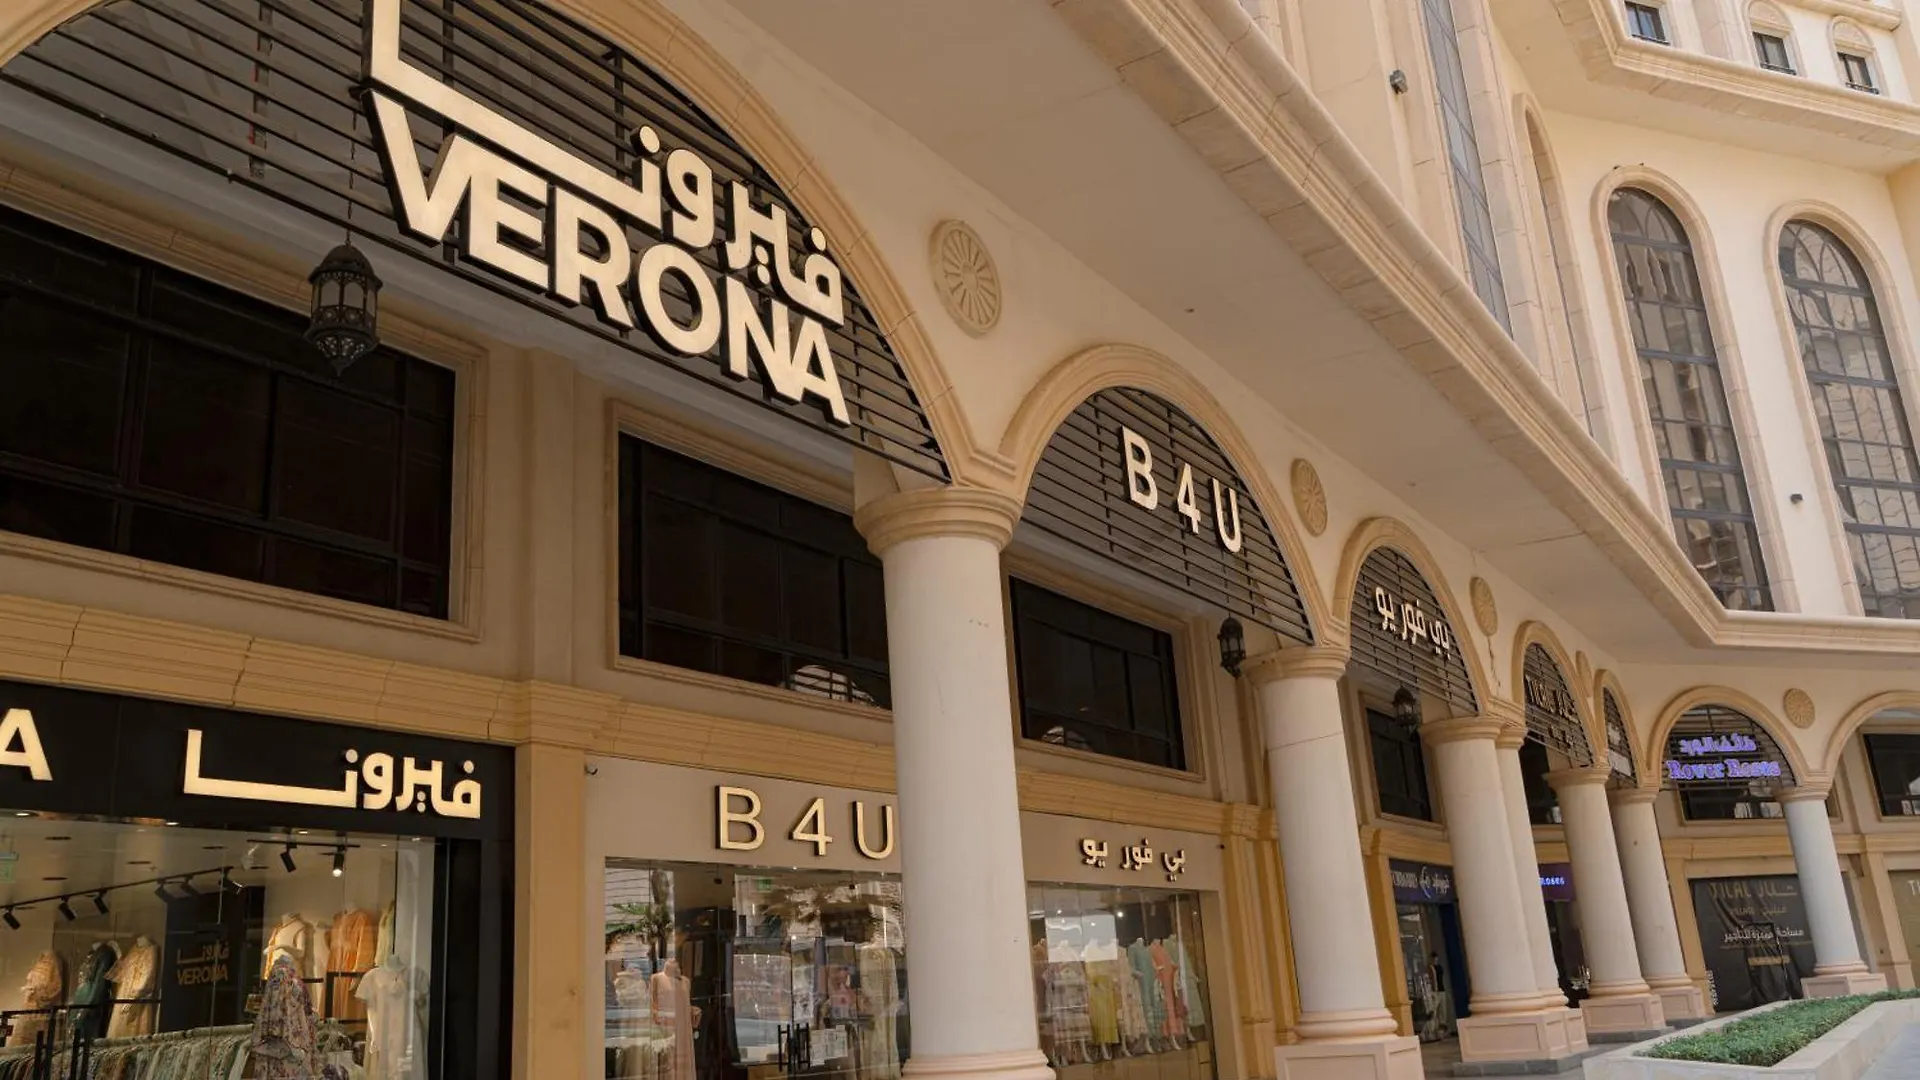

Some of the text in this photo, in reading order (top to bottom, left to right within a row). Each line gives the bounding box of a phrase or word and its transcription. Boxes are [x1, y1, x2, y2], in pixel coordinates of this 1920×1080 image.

[368, 88, 851, 427] VERONA
[183, 728, 481, 820] فيرونا
[1082, 837, 1185, 881] بي فور يو
